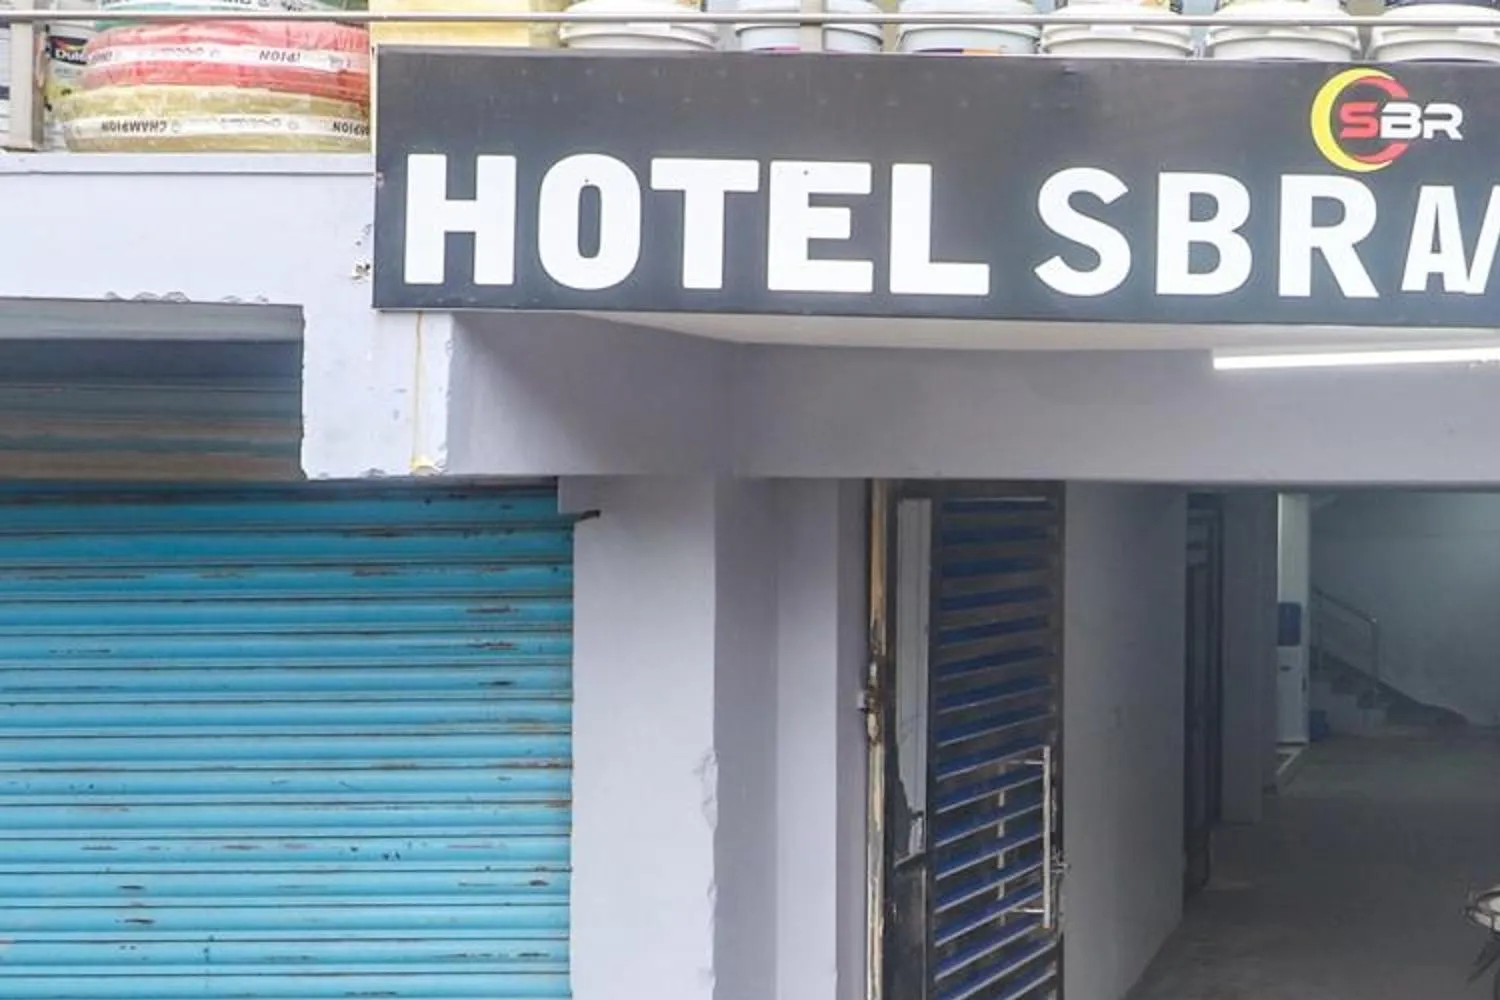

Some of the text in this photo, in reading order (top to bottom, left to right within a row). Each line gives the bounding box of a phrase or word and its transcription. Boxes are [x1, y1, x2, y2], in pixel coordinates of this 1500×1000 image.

[101, 119, 167, 133] CHAMPION
[1340, 102, 1463, 140] SBR
[404, 153, 991, 296] HOTEL
[1034, 166, 1380, 299] SBR
